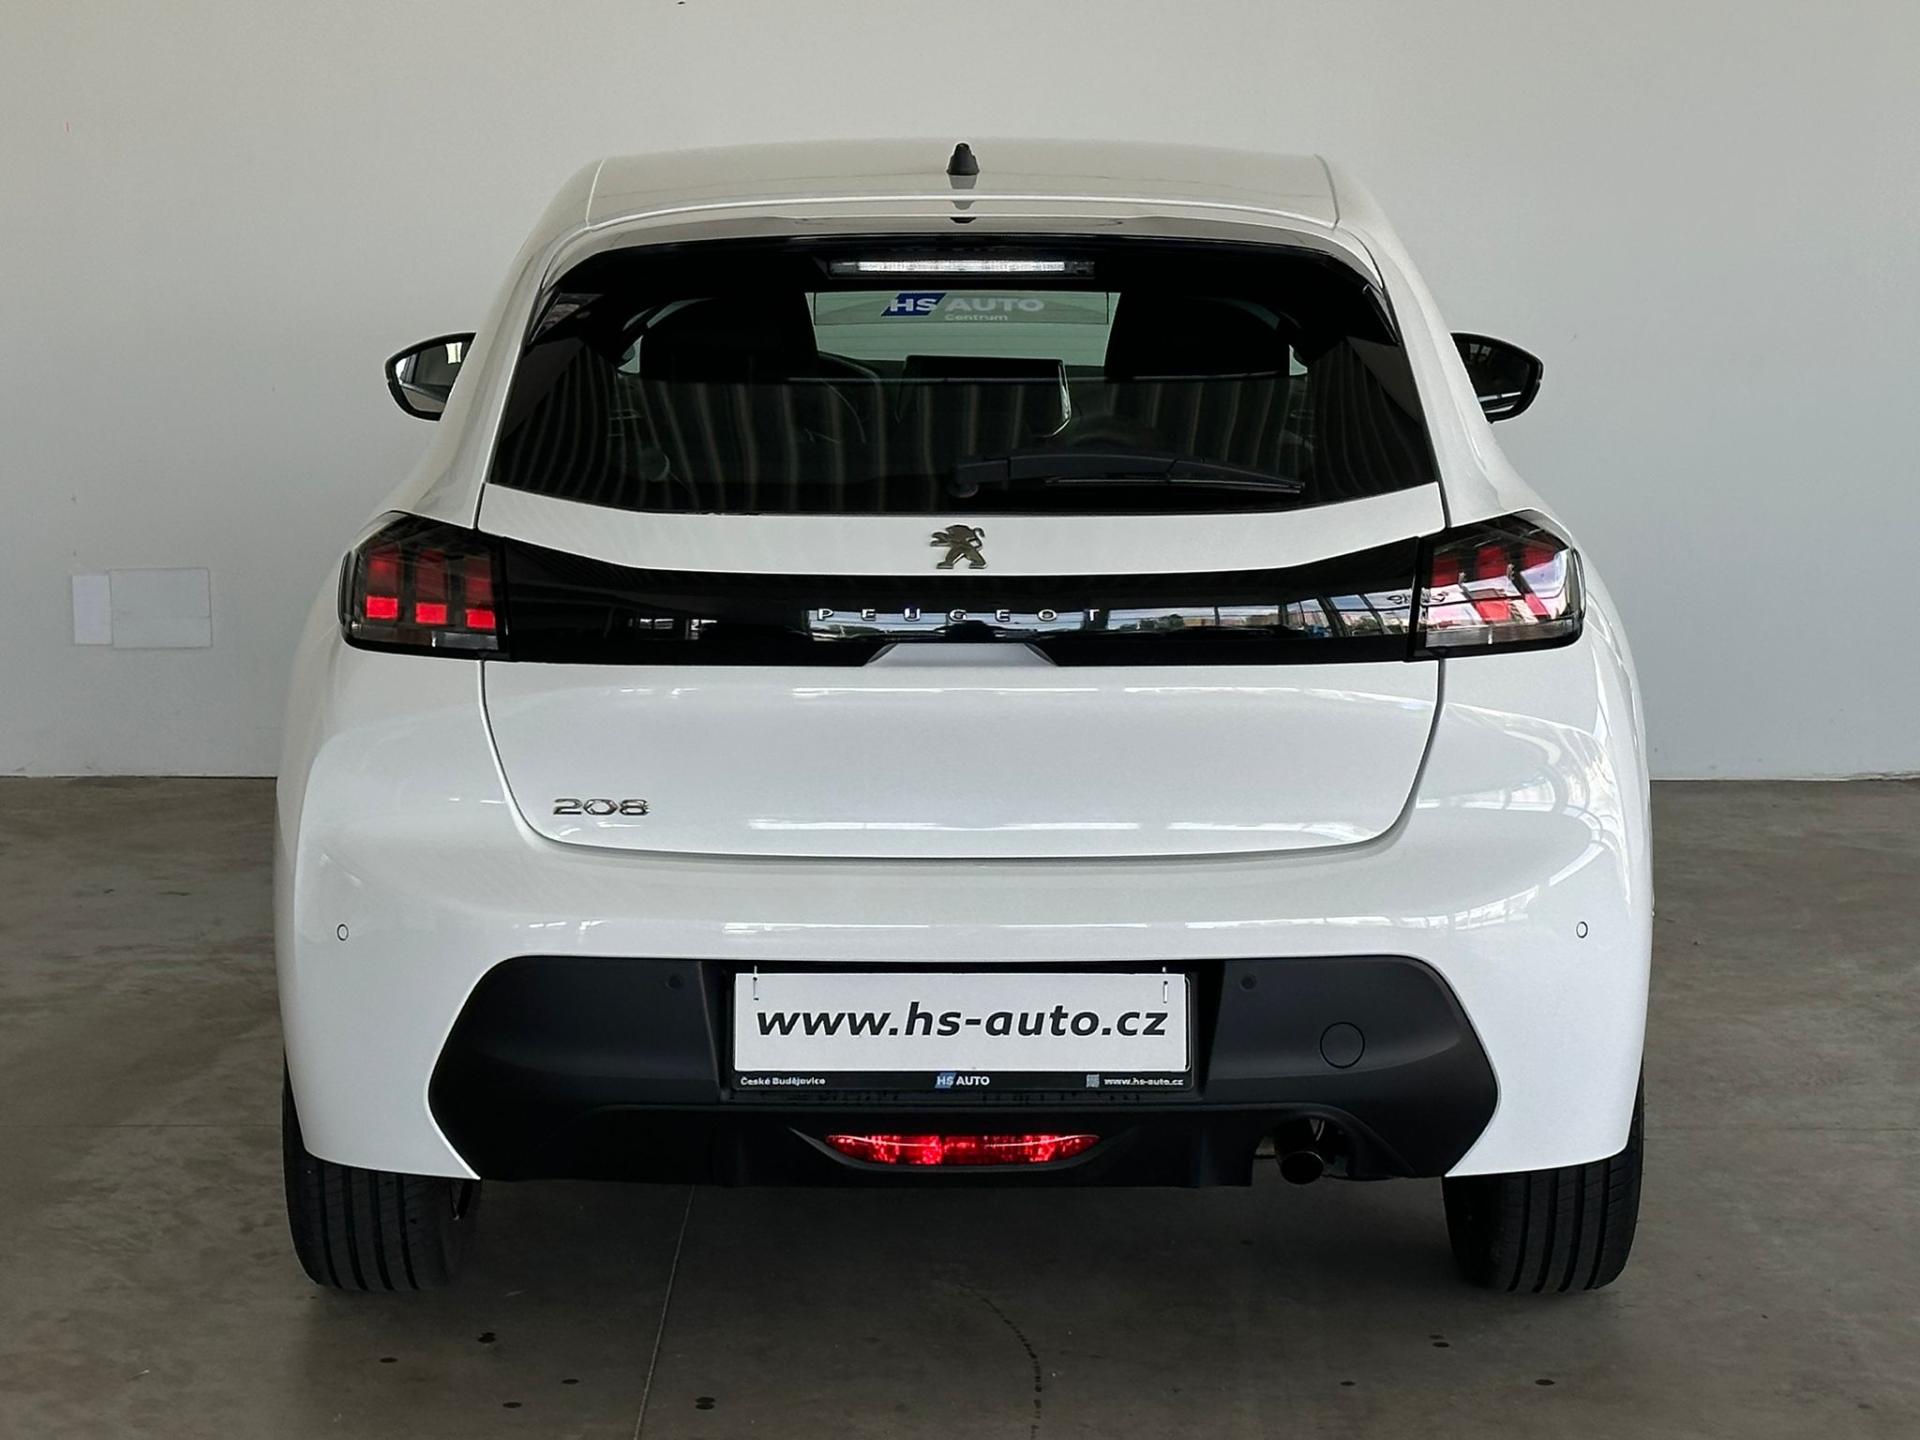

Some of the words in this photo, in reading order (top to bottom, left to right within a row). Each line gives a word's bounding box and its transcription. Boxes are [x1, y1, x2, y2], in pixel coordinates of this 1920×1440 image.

[889, 298, 938, 312] HS
[945, 298, 1045, 312] AUTO
[945, 313, 1009, 321] Centrum
[818, 607, 1100, 622] PEUGEOT
[553, 798, 649, 816] 208
[757, 1001, 1168, 1036] www.hs-auto.cz
[936, 1075, 955, 1086] HS
[956, 1075, 990, 1086] AUTO
[1103, 1077, 1184, 1086] www.hs-auto.cz
